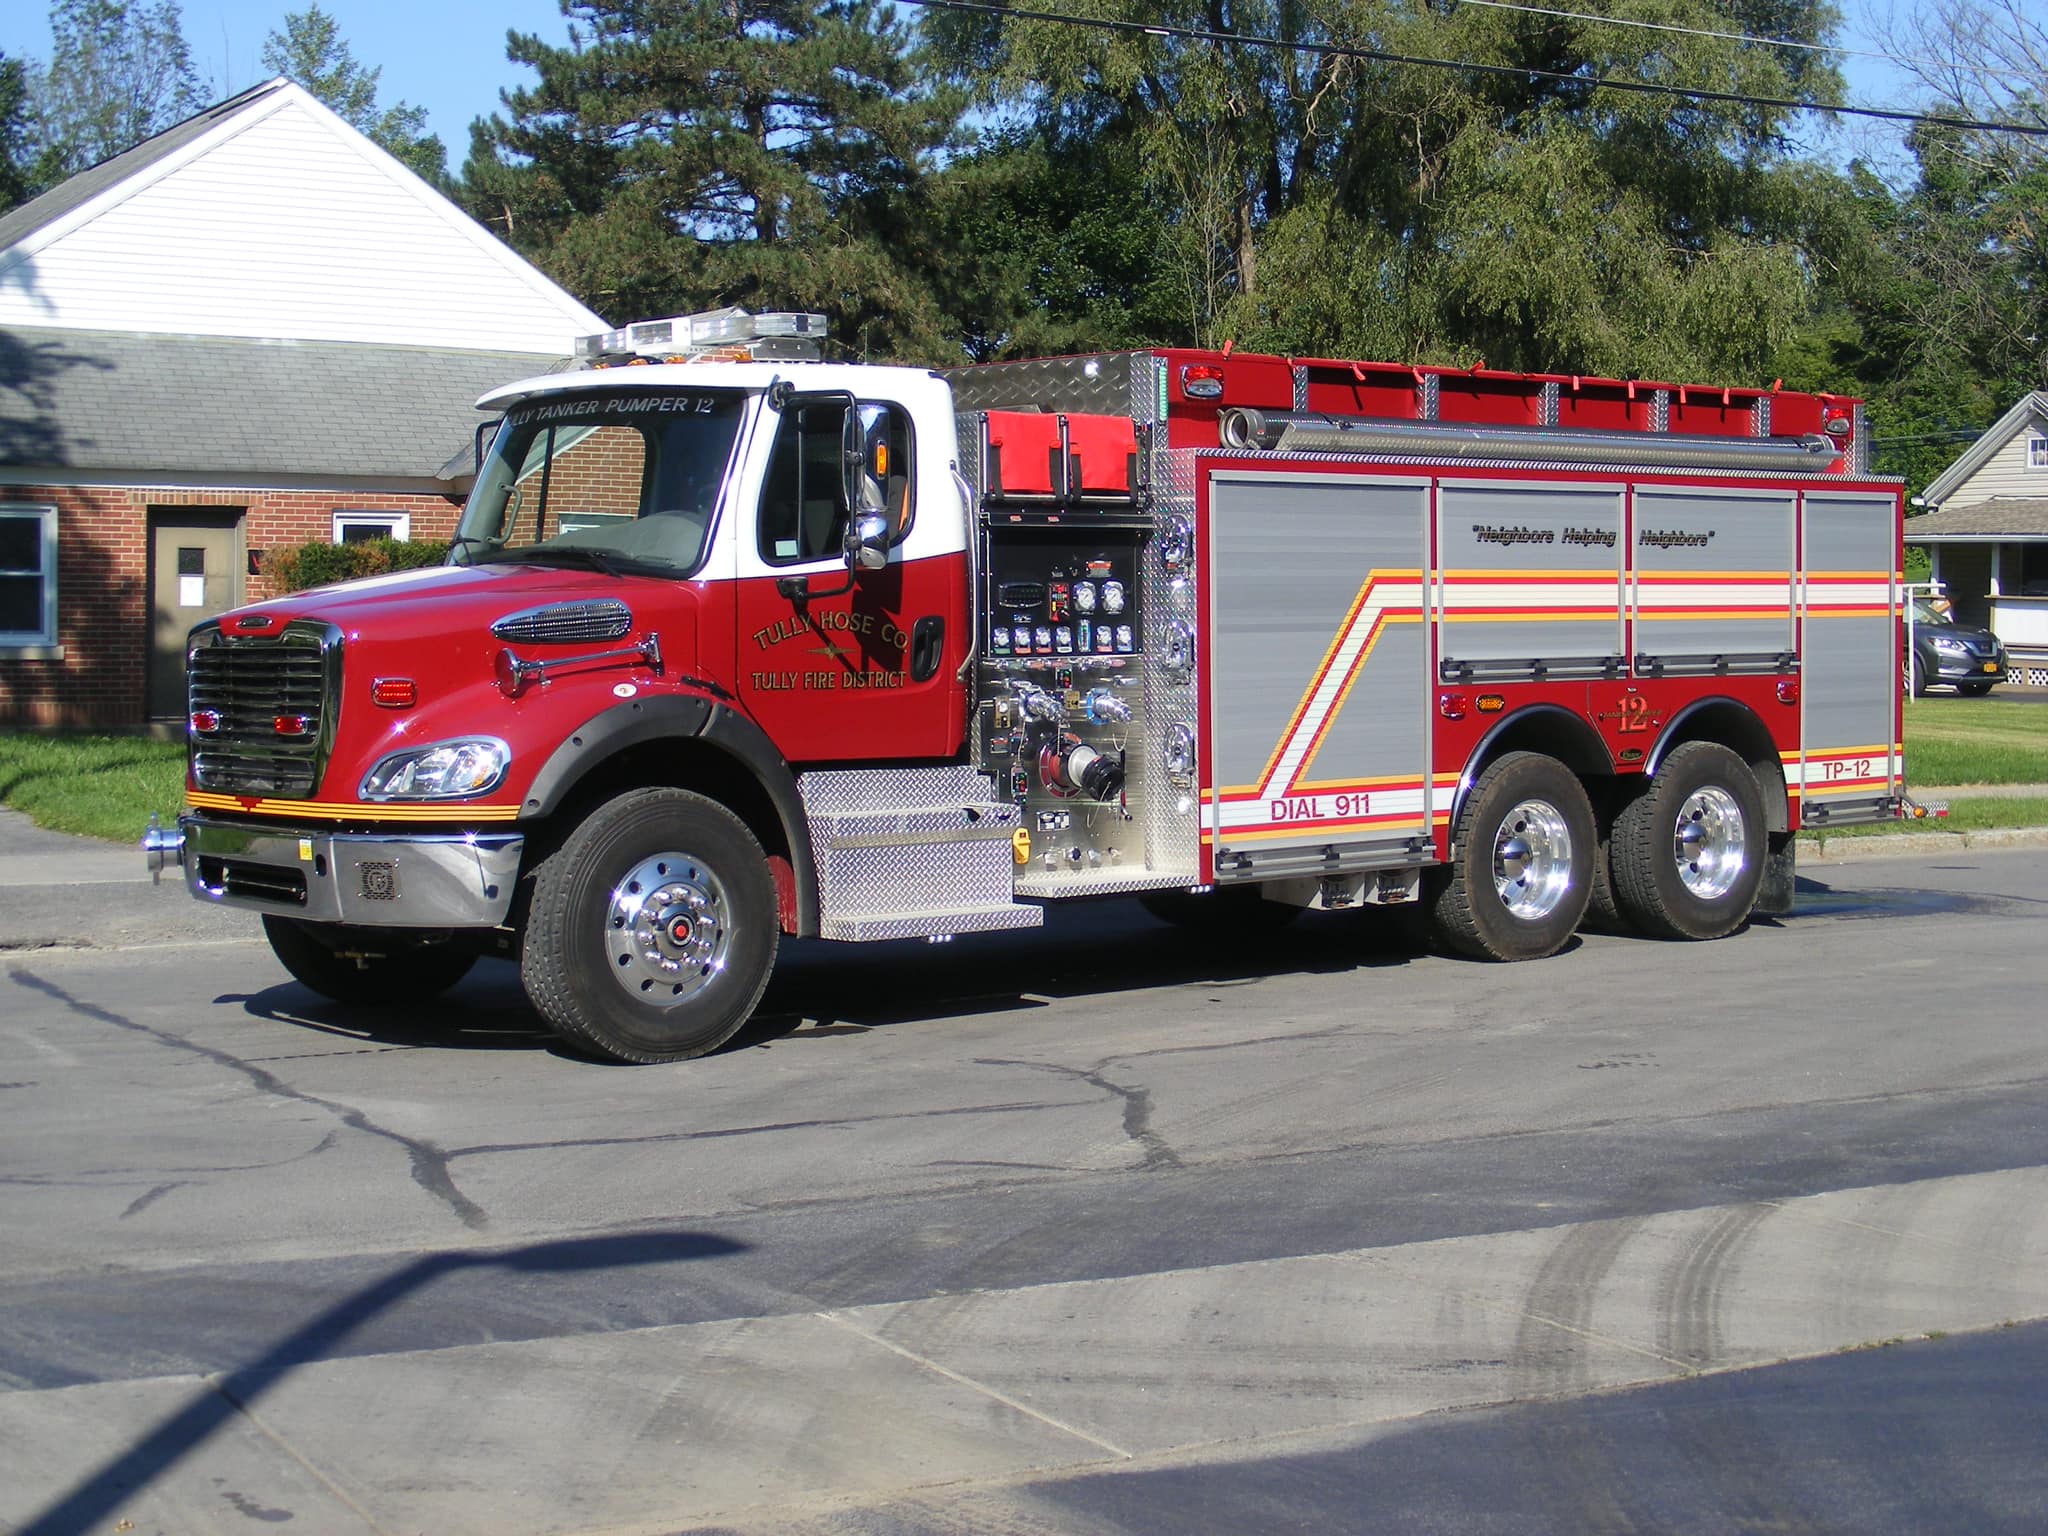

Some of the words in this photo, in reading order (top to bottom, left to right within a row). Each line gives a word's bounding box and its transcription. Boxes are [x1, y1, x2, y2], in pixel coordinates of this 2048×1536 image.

[536, 400, 599, 421] TANKER
[604, 397, 687, 413] PUMPER
[694, 398, 714, 414] 12
[1561, 528, 1617, 547] Helping
[753, 612, 812, 650] TULLY
[820, 610, 875, 635] HOSE
[752, 672, 798, 690] TULLY
[804, 672, 836, 689] FIRE
[843, 671, 907, 689] DISTRICT
[1616, 695, 1648, 733] 12
[1822, 759, 1871, 780] TP-12
[1271, 798, 1325, 821] DIAL
[1335, 794, 1370, 816] 911
